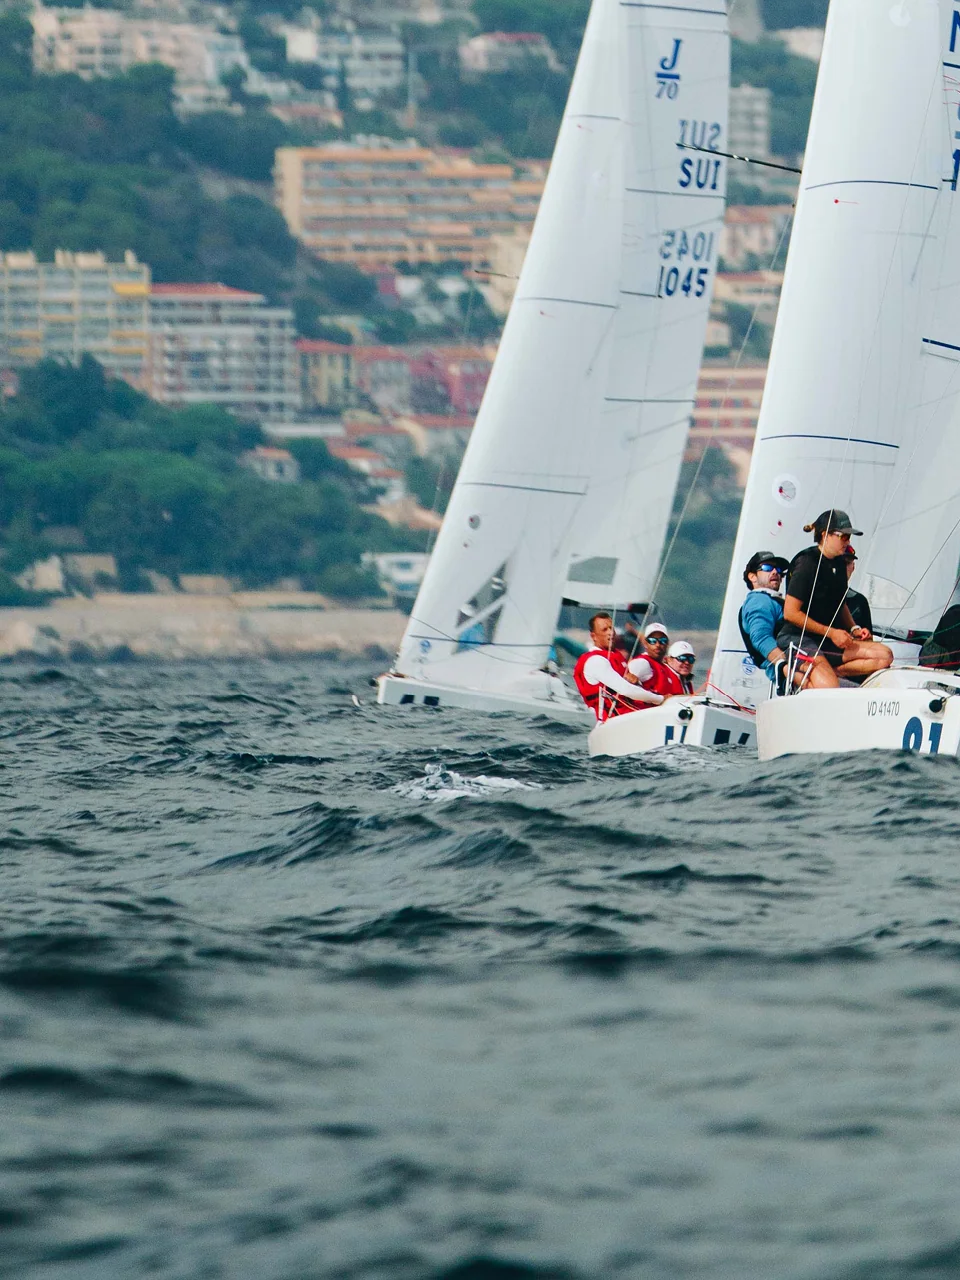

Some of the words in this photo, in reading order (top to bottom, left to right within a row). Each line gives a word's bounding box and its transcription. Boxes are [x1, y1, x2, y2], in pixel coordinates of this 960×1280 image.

[660, 38, 683, 71] J
[655, 80, 679, 100] 70
[678, 158, 721, 190] SUI
[658, 265, 708, 297] 1045
[867, 701, 877, 716] VD
[878, 701, 900, 716] 41470
